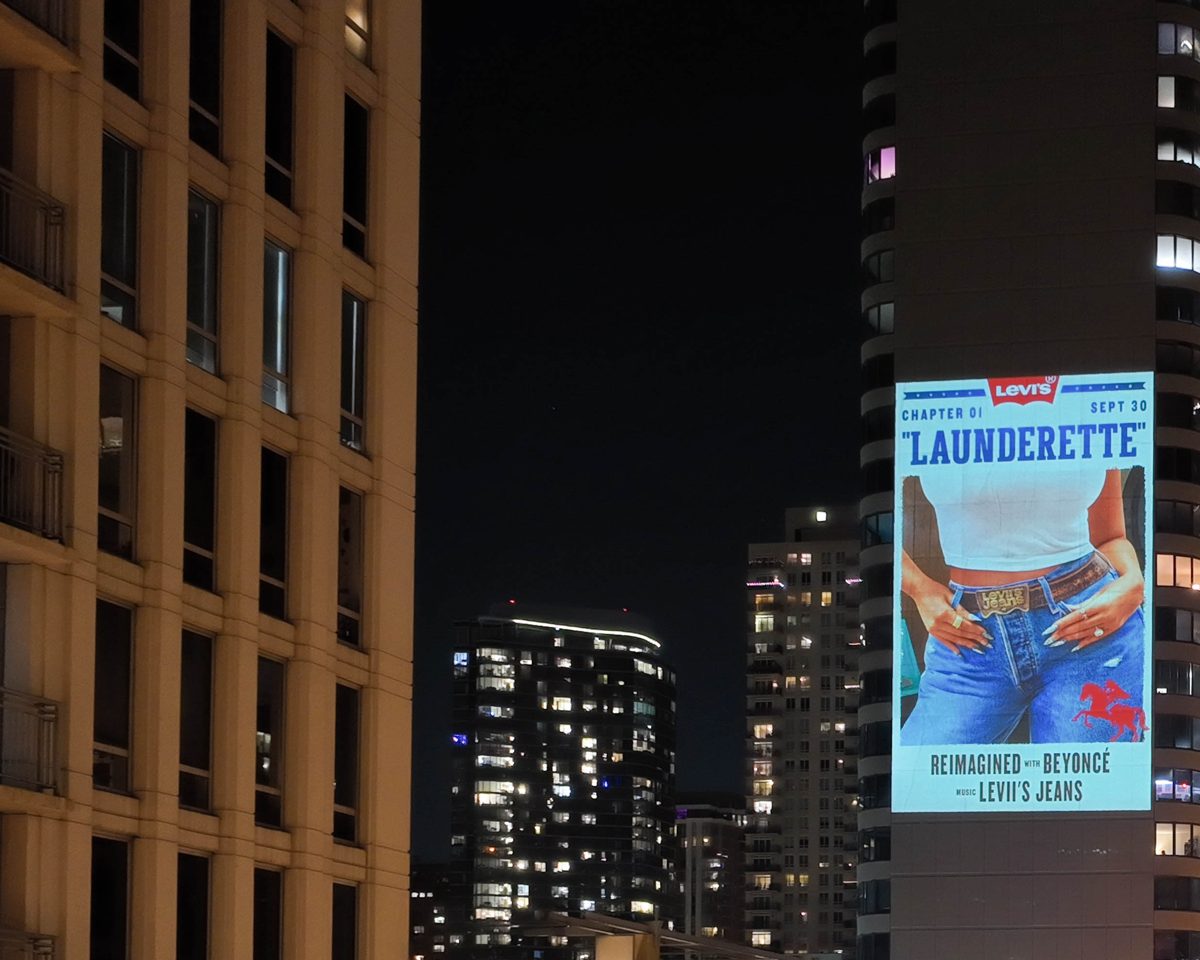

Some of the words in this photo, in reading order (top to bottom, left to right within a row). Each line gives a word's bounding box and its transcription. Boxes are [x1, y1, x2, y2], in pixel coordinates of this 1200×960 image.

[902, 407, 963, 421] CHAPTER
[1091, 401, 1125, 414] SEPT
[1131, 400, 1147, 412] 30
[902, 422, 1146, 466] "LAUNDERETTE"
[931, 754, 1021, 775] REIMAGINED
[1043, 748, 1110, 774] BEYONCÉ
[979, 781, 1030, 802] LEVII'S
[1036, 780, 1083, 802] JEANS
